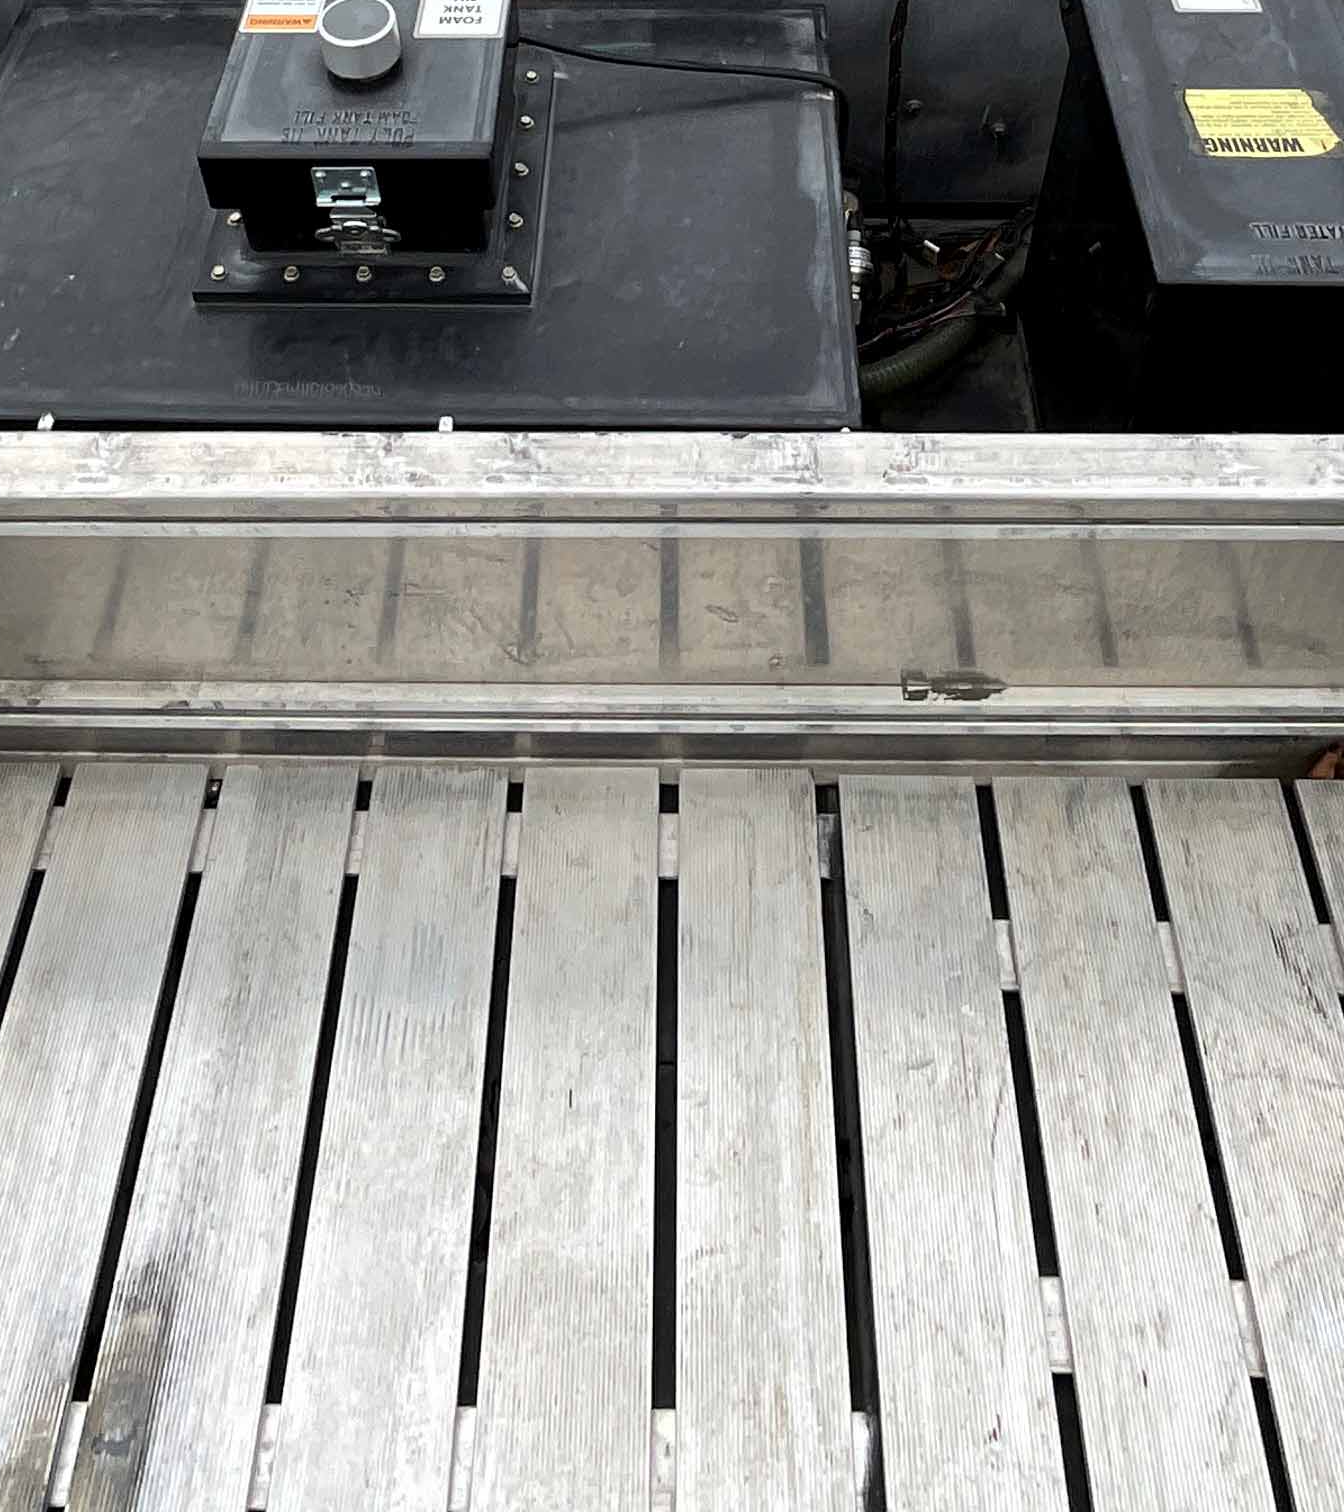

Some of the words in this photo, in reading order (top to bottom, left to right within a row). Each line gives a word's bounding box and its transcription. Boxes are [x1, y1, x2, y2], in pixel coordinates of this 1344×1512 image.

[443, 4, 482, 14] TANK
[438, 16, 483, 25] FOAM
[1204, 137, 1304, 153] WARNING
[1248, 222, 1292, 240] FILL
